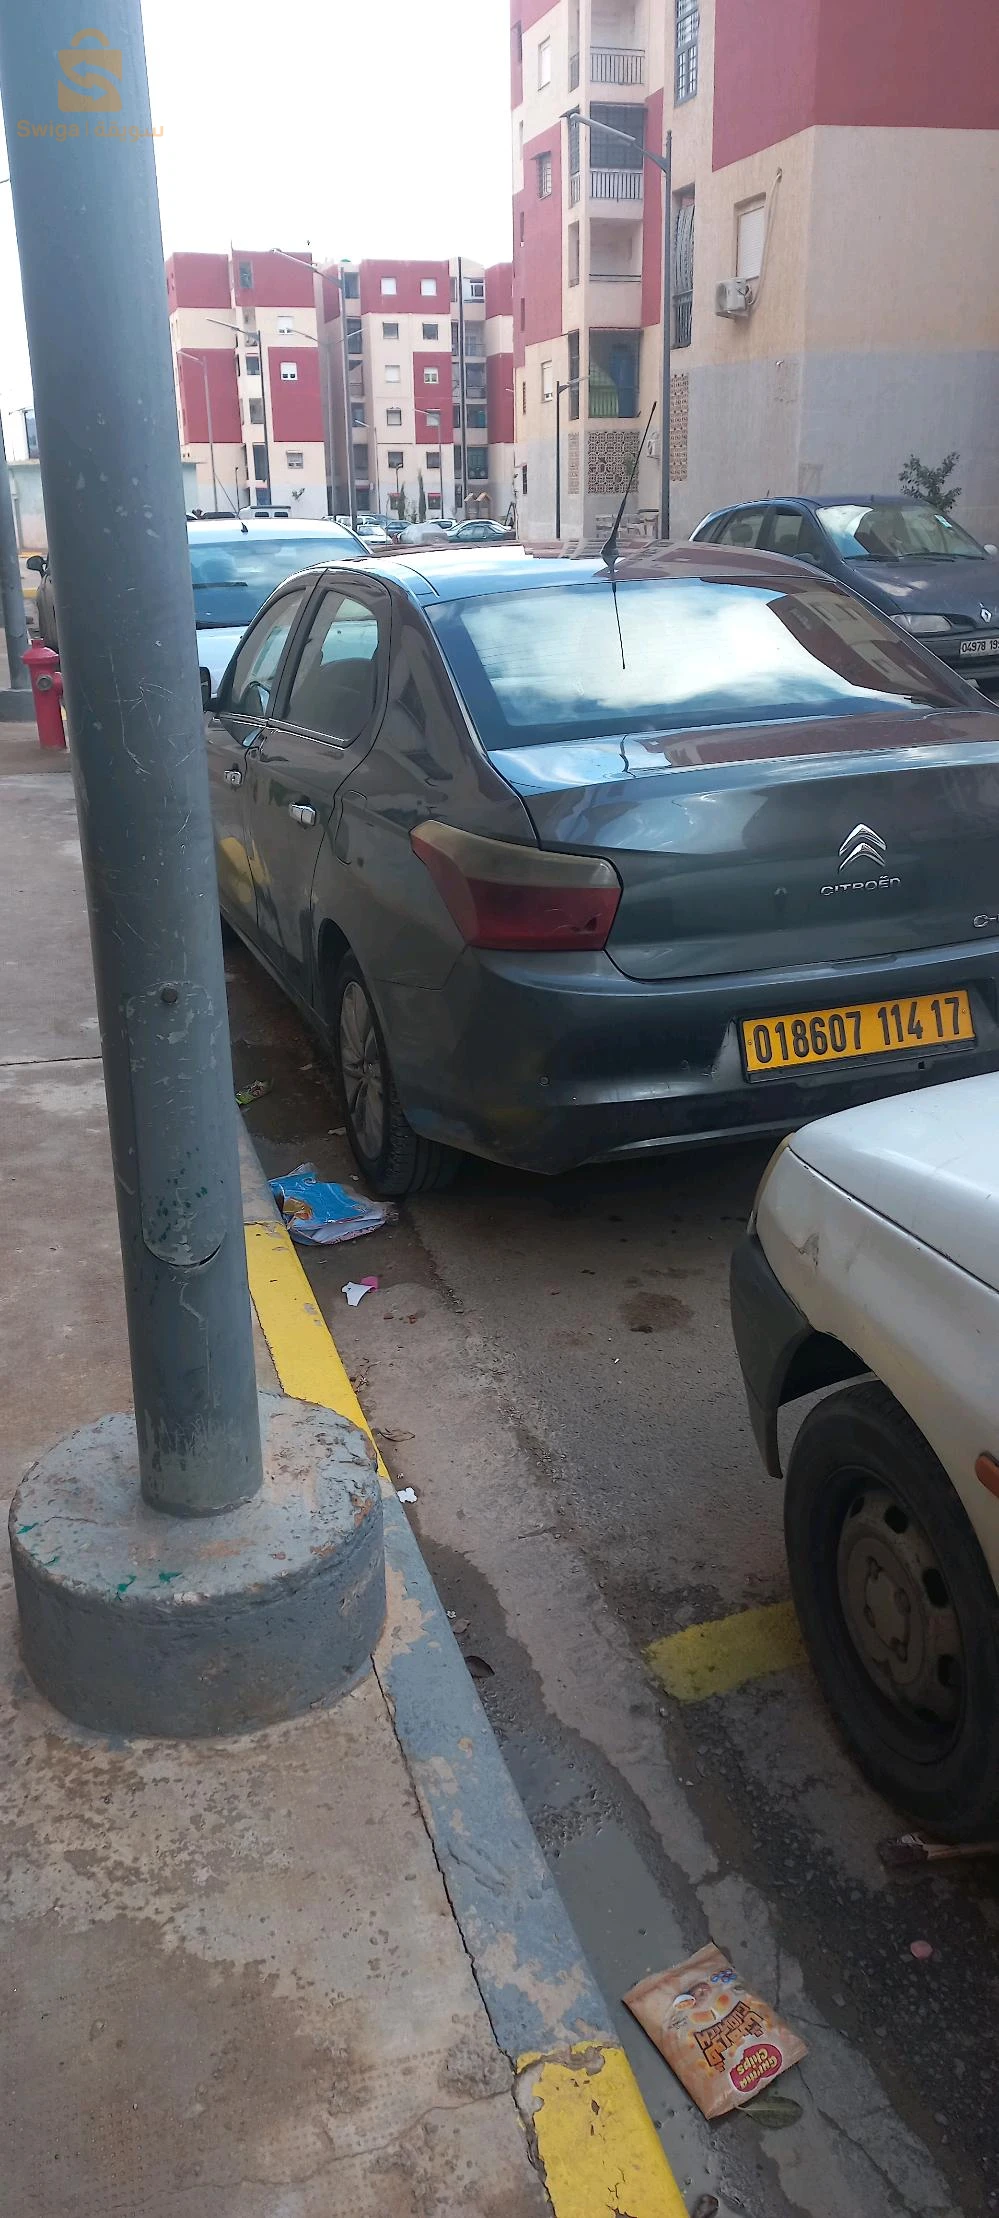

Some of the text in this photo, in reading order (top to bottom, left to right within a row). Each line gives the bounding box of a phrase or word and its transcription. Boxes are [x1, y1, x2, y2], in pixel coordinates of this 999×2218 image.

[962, 639, 999, 653] 04978 19
[973, 914, 999, 928] C-
[753, 996, 960, 1063] 018607 114 17
[737, 2047, 768, 2076] Chips
